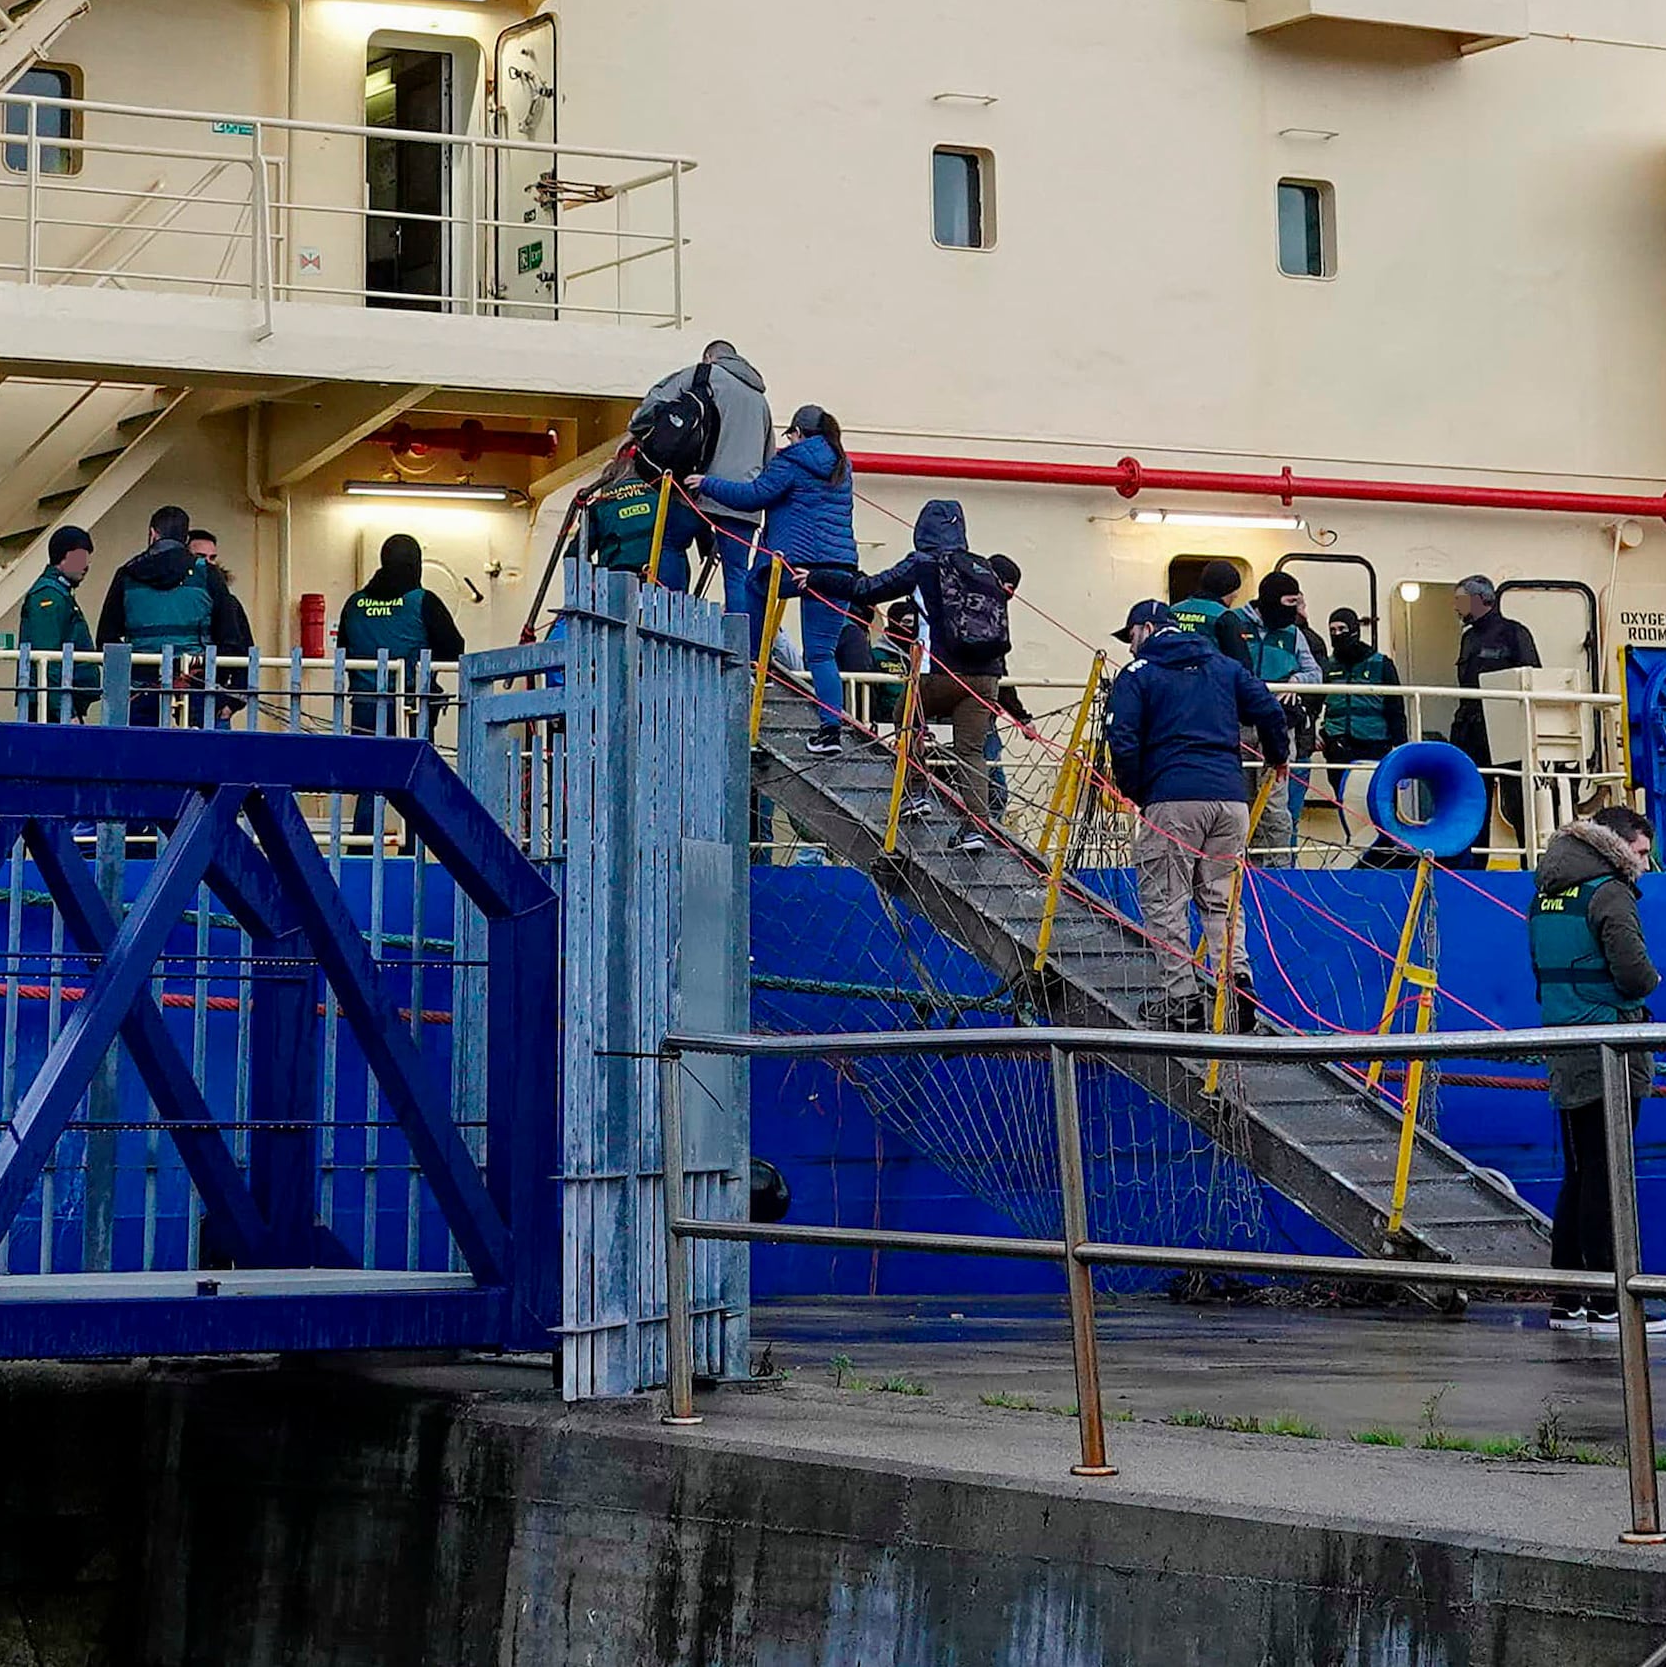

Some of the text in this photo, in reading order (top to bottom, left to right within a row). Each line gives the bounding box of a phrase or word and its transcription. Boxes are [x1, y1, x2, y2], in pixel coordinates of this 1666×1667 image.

[616, 489, 646, 501] CIVIL
[620, 504, 649, 517] UCO
[365, 606, 393, 617] CIVIL
[1540, 898, 1565, 911] CIVIL
